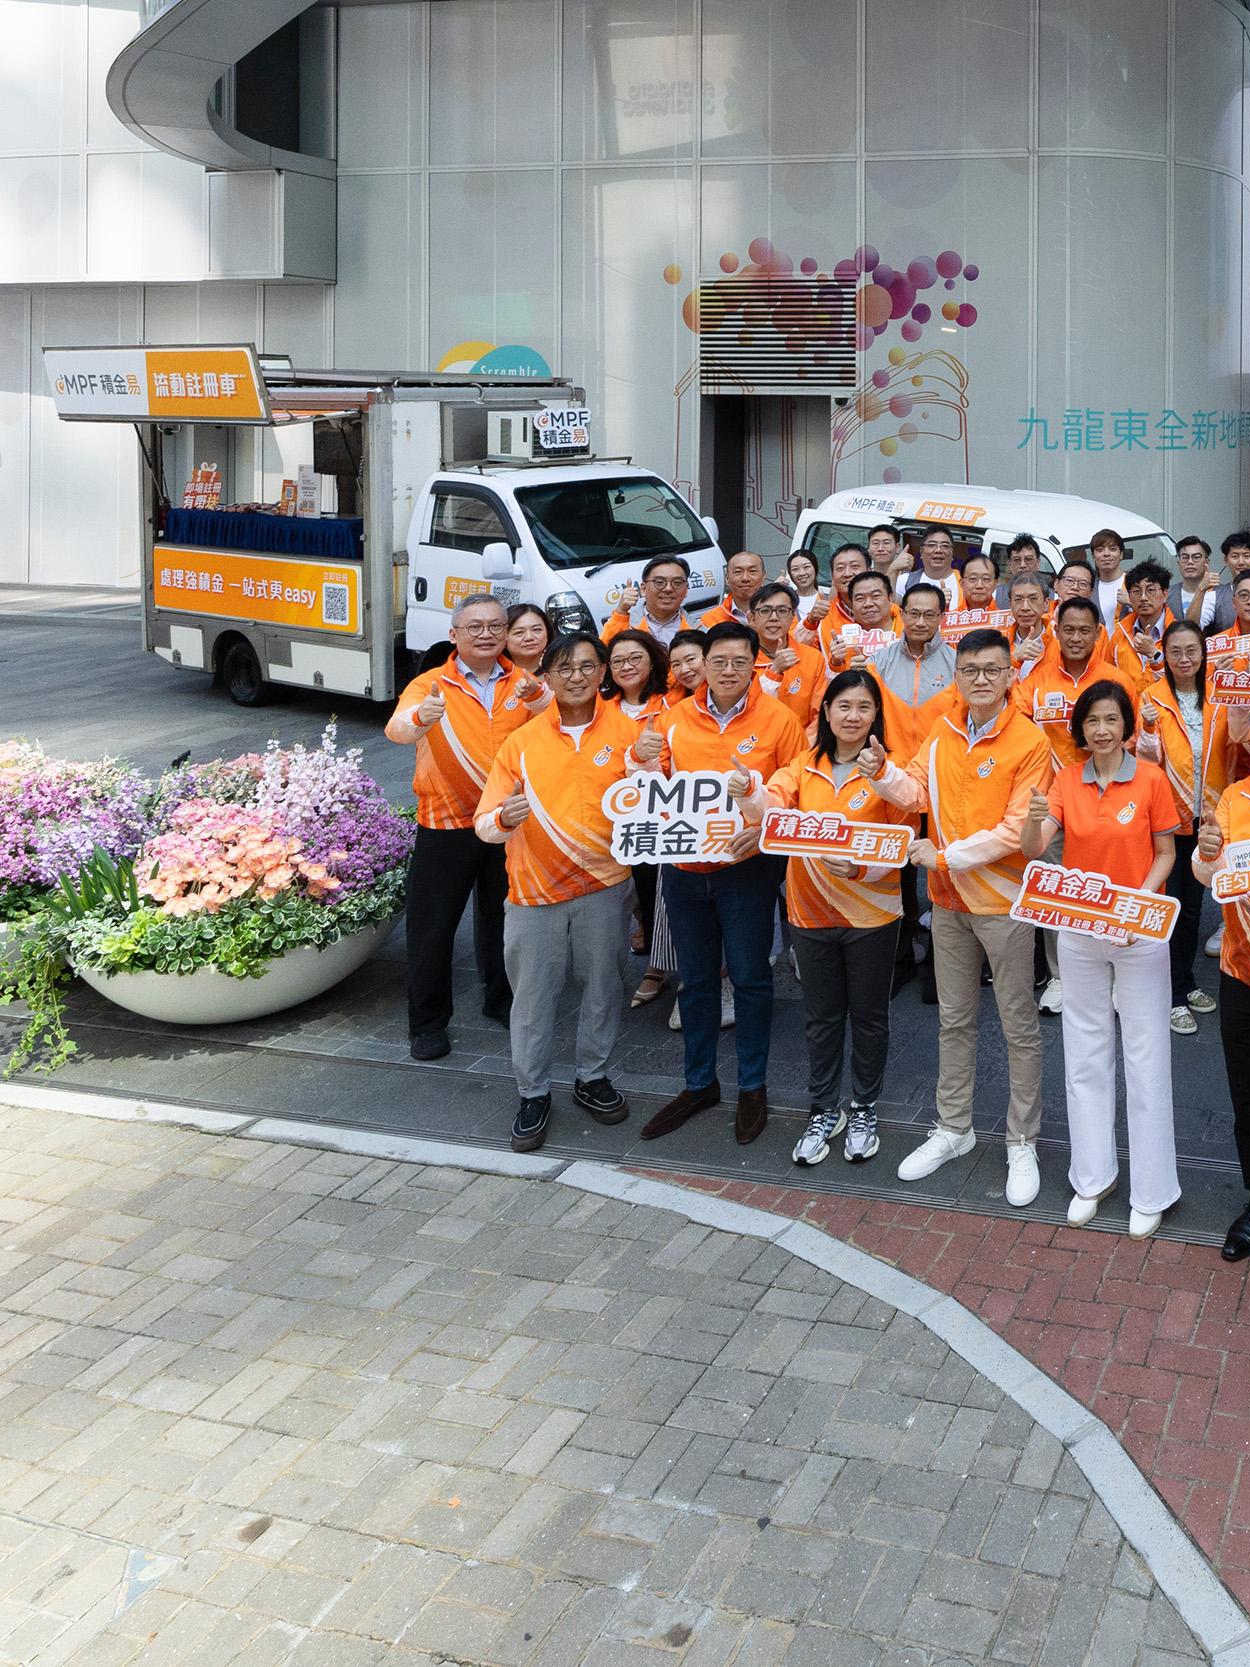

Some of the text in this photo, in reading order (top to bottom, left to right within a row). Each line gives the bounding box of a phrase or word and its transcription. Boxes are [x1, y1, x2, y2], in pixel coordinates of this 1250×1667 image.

[100, 374, 141, 395] 積金易
[153, 373, 239, 398] 流動註冊車
[537, 410, 589, 427] eMPF
[543, 429, 586, 445] 積金易
[160, 568, 317, 608] 處理強積金 一站式更easy
[619, 820, 736, 857] 積金易
